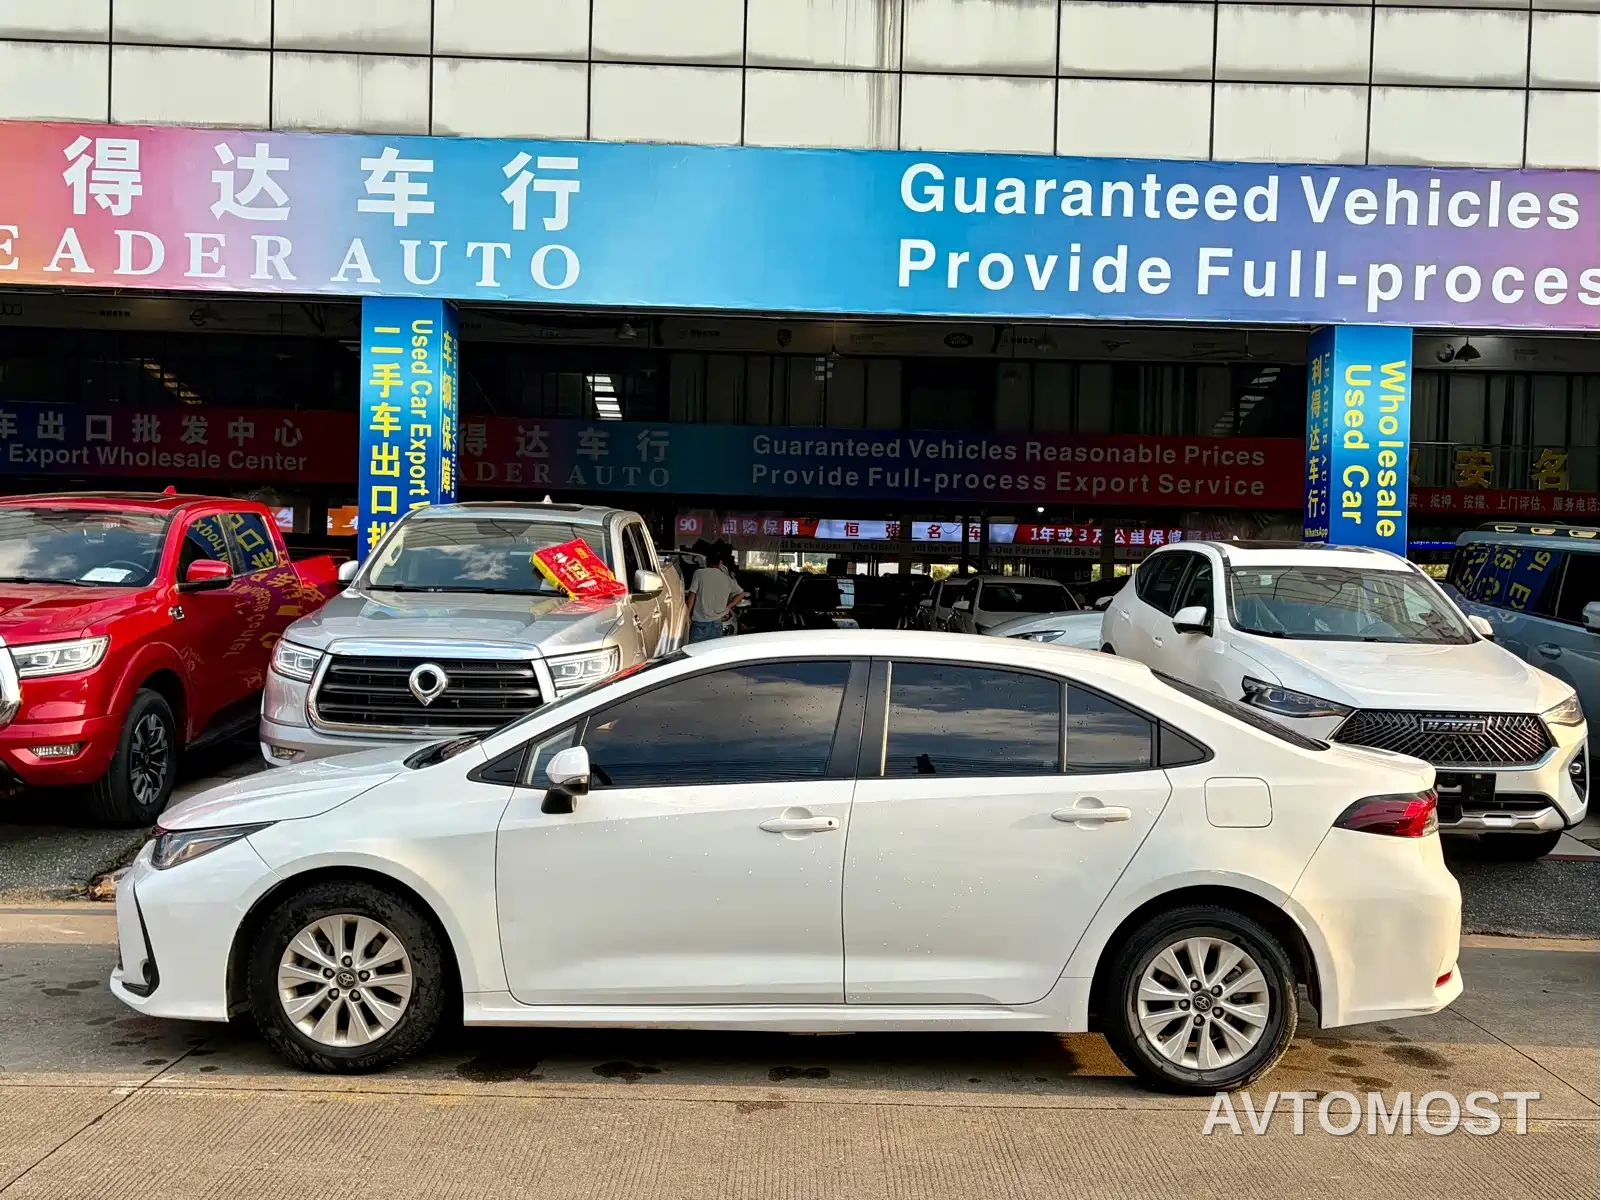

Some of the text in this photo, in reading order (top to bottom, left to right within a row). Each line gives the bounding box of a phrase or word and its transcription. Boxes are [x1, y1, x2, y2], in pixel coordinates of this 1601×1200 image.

[62, 135, 581, 231] 得达车行
[900, 162, 1580, 230] Guaranteed Vehicles
[330, 237, 581, 290] AUTO
[898, 238, 1173, 298] Provide
[411, 319, 433, 374] Used
[410, 380, 432, 418] Car
[459, 423, 670, 463] 得达车行
[752, 434, 1265, 467] Guaranteed Vehicles Reasonable Prices
[1320, 352, 1331, 516] LEADER AUTO
[1341, 364, 1373, 525] Used Car
[1376, 360, 1407, 537] Wholesale
[9, 443, 307, 472] Export Wholesale Center
[405, 424, 432, 496] Export
[565, 464, 670, 487] AUTO
[752, 464, 1265, 498] Provide Full-process Export Service
[679, 518, 698, 531] 90
[1304, 527, 1329, 538] WhatsApp
[1425, 721, 1485, 733] HAVAL
